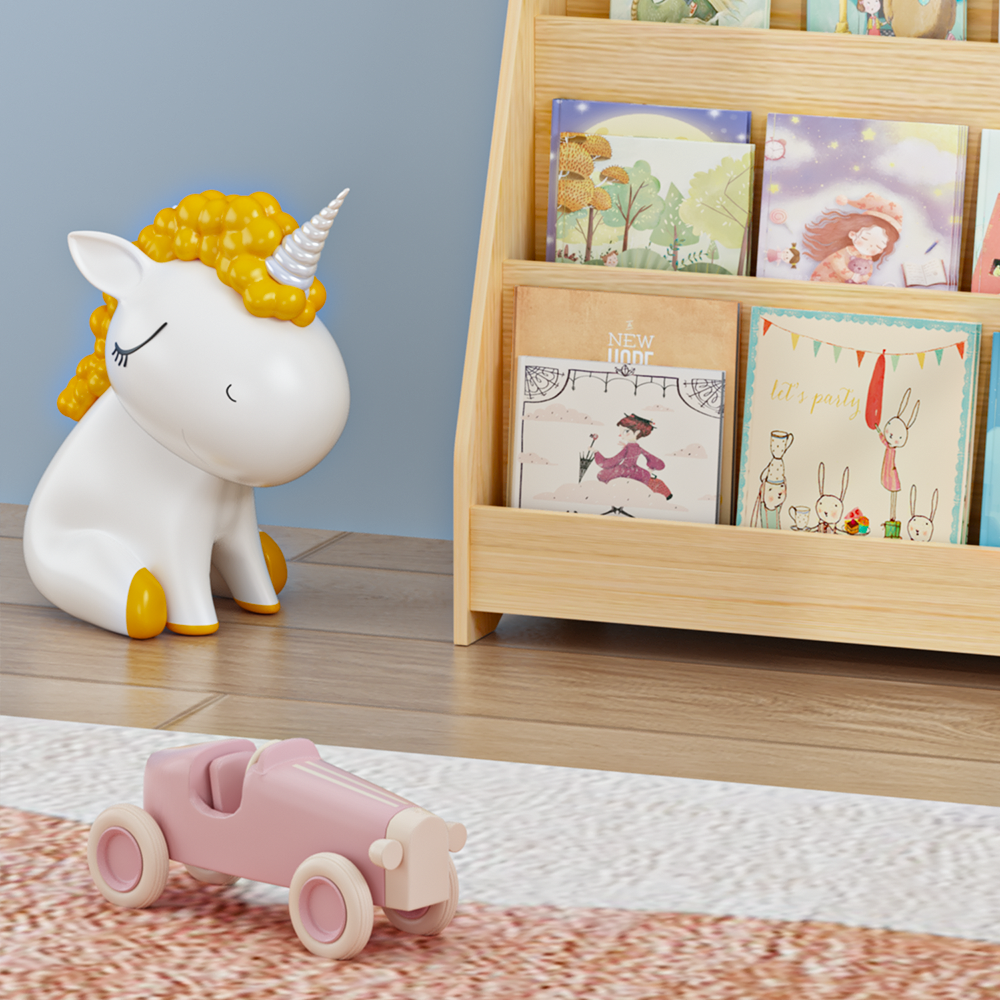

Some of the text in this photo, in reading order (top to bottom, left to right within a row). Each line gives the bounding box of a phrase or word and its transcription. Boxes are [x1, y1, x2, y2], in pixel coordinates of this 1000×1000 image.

[607, 331, 656, 349] NEW
[770, 379, 862, 421] let's party
